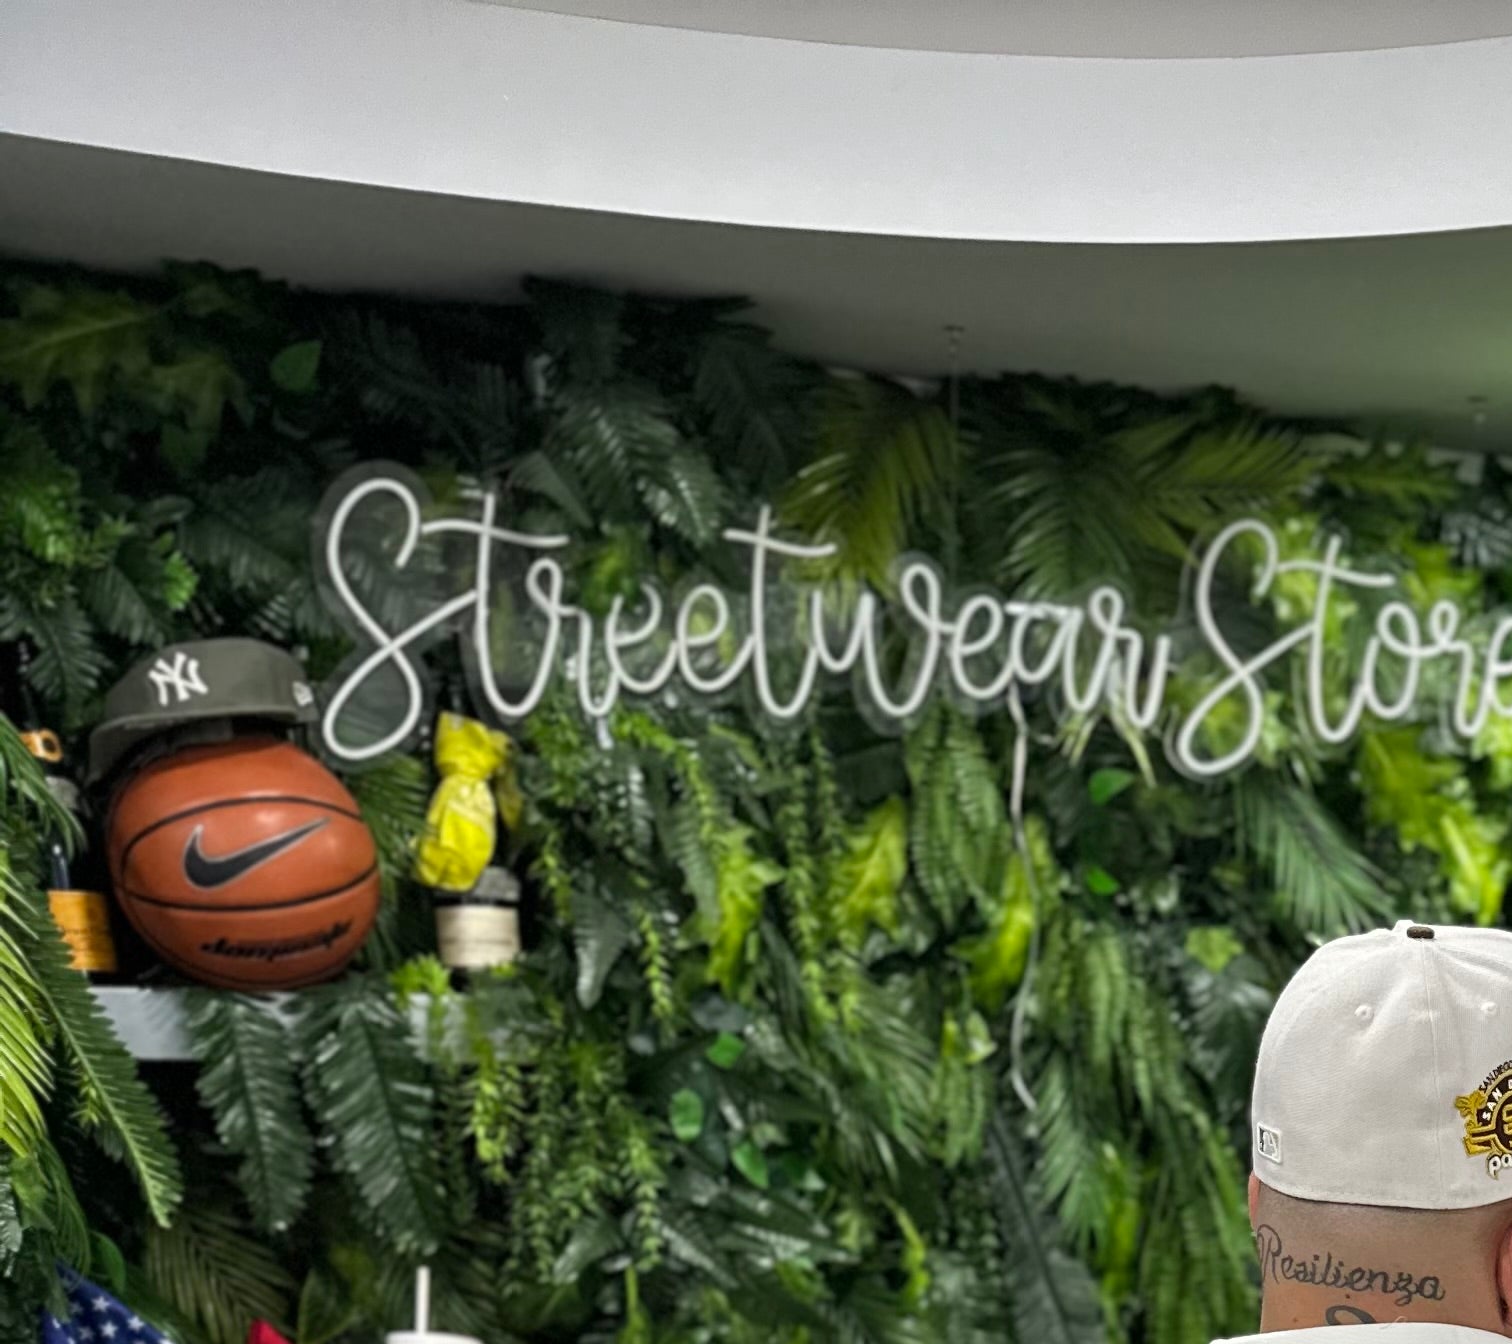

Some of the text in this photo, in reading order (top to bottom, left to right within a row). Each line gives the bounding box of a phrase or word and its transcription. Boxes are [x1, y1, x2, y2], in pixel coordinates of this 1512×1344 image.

[322, 477, 1171, 760] Streetwear
[148, 651, 209, 707] NY
[1481, 1087, 1503, 1121] SAN
[1256, 1223, 1447, 1306] Resilienza
